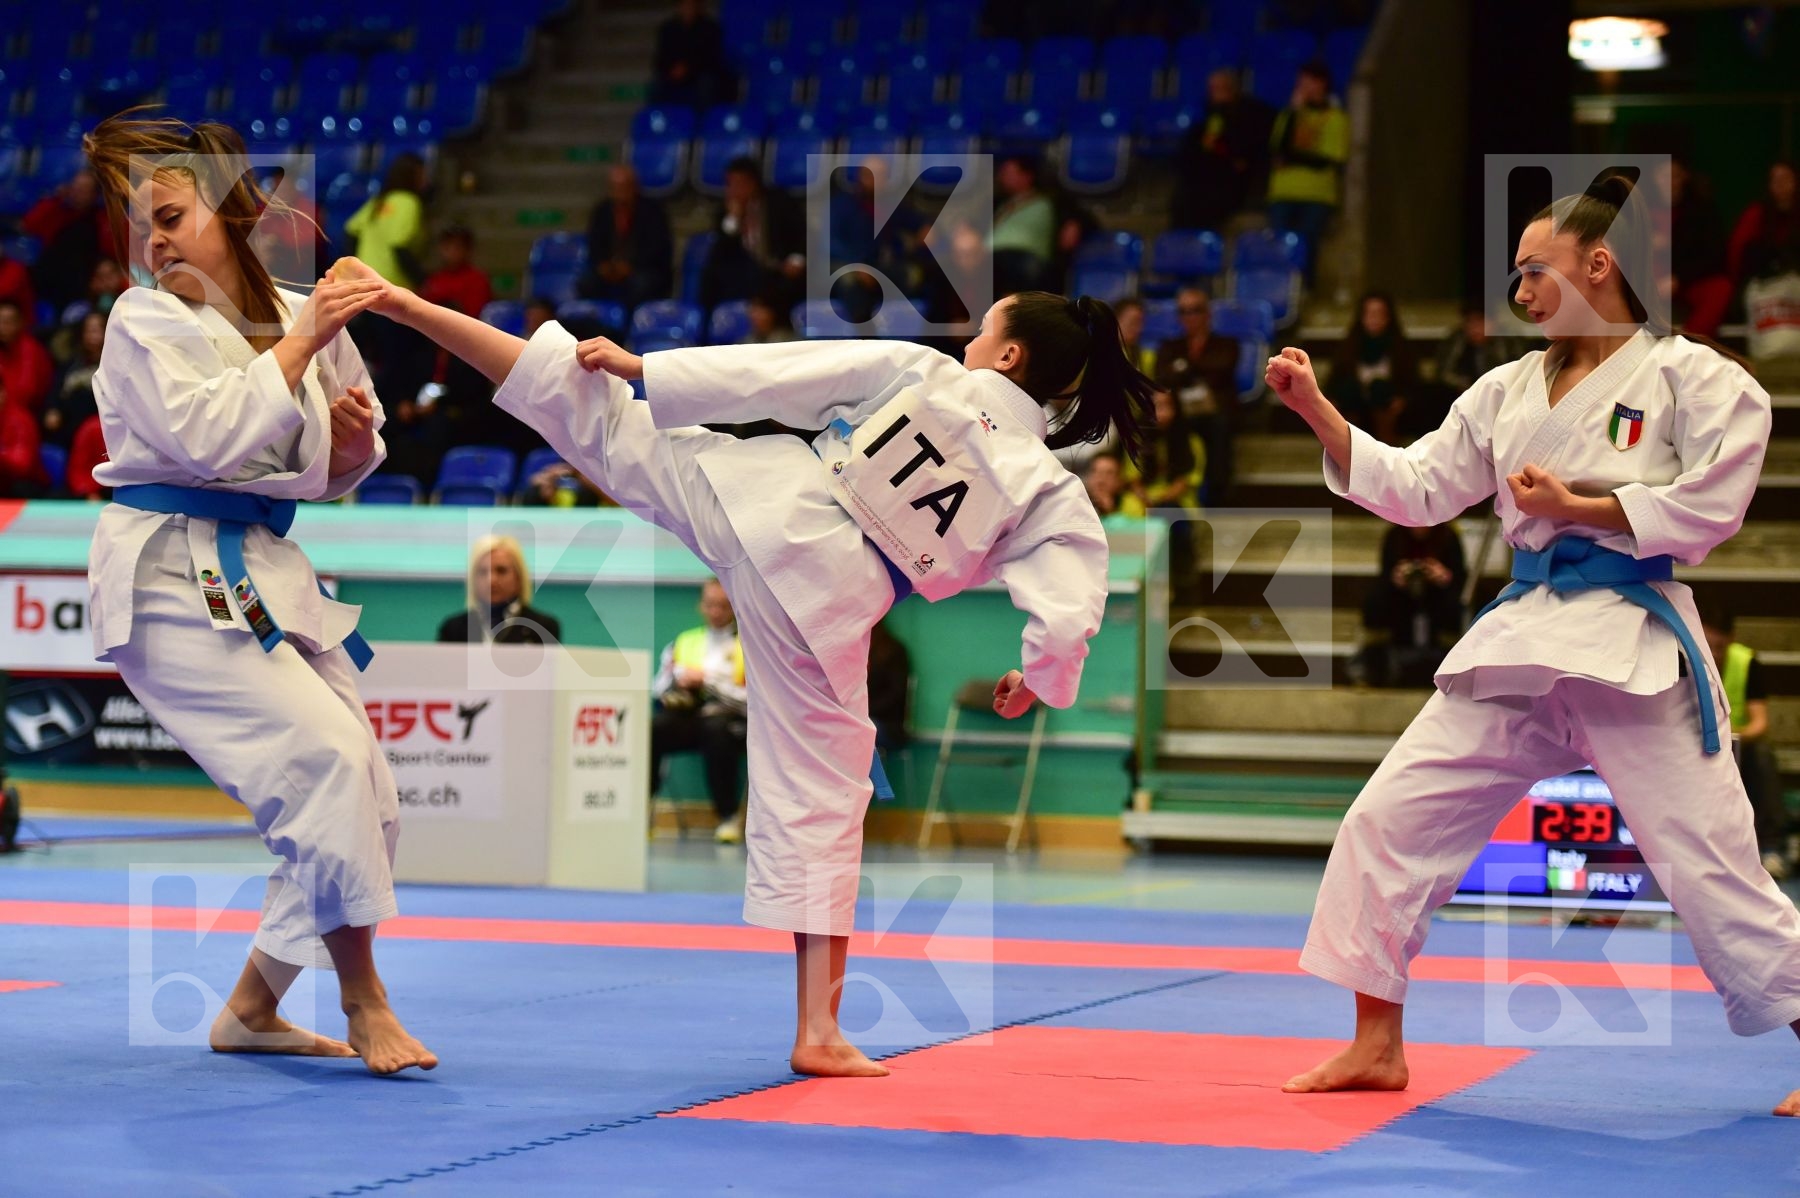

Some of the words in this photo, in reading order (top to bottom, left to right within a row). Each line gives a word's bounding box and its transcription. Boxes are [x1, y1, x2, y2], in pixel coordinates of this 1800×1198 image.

[1615, 405, 1641, 419] ITALIA
[863, 414, 969, 538] ITA
[15, 584, 91, 630] ba
[1541, 802, 1613, 842] 2:39
[1587, 872, 1643, 893] ITALY
